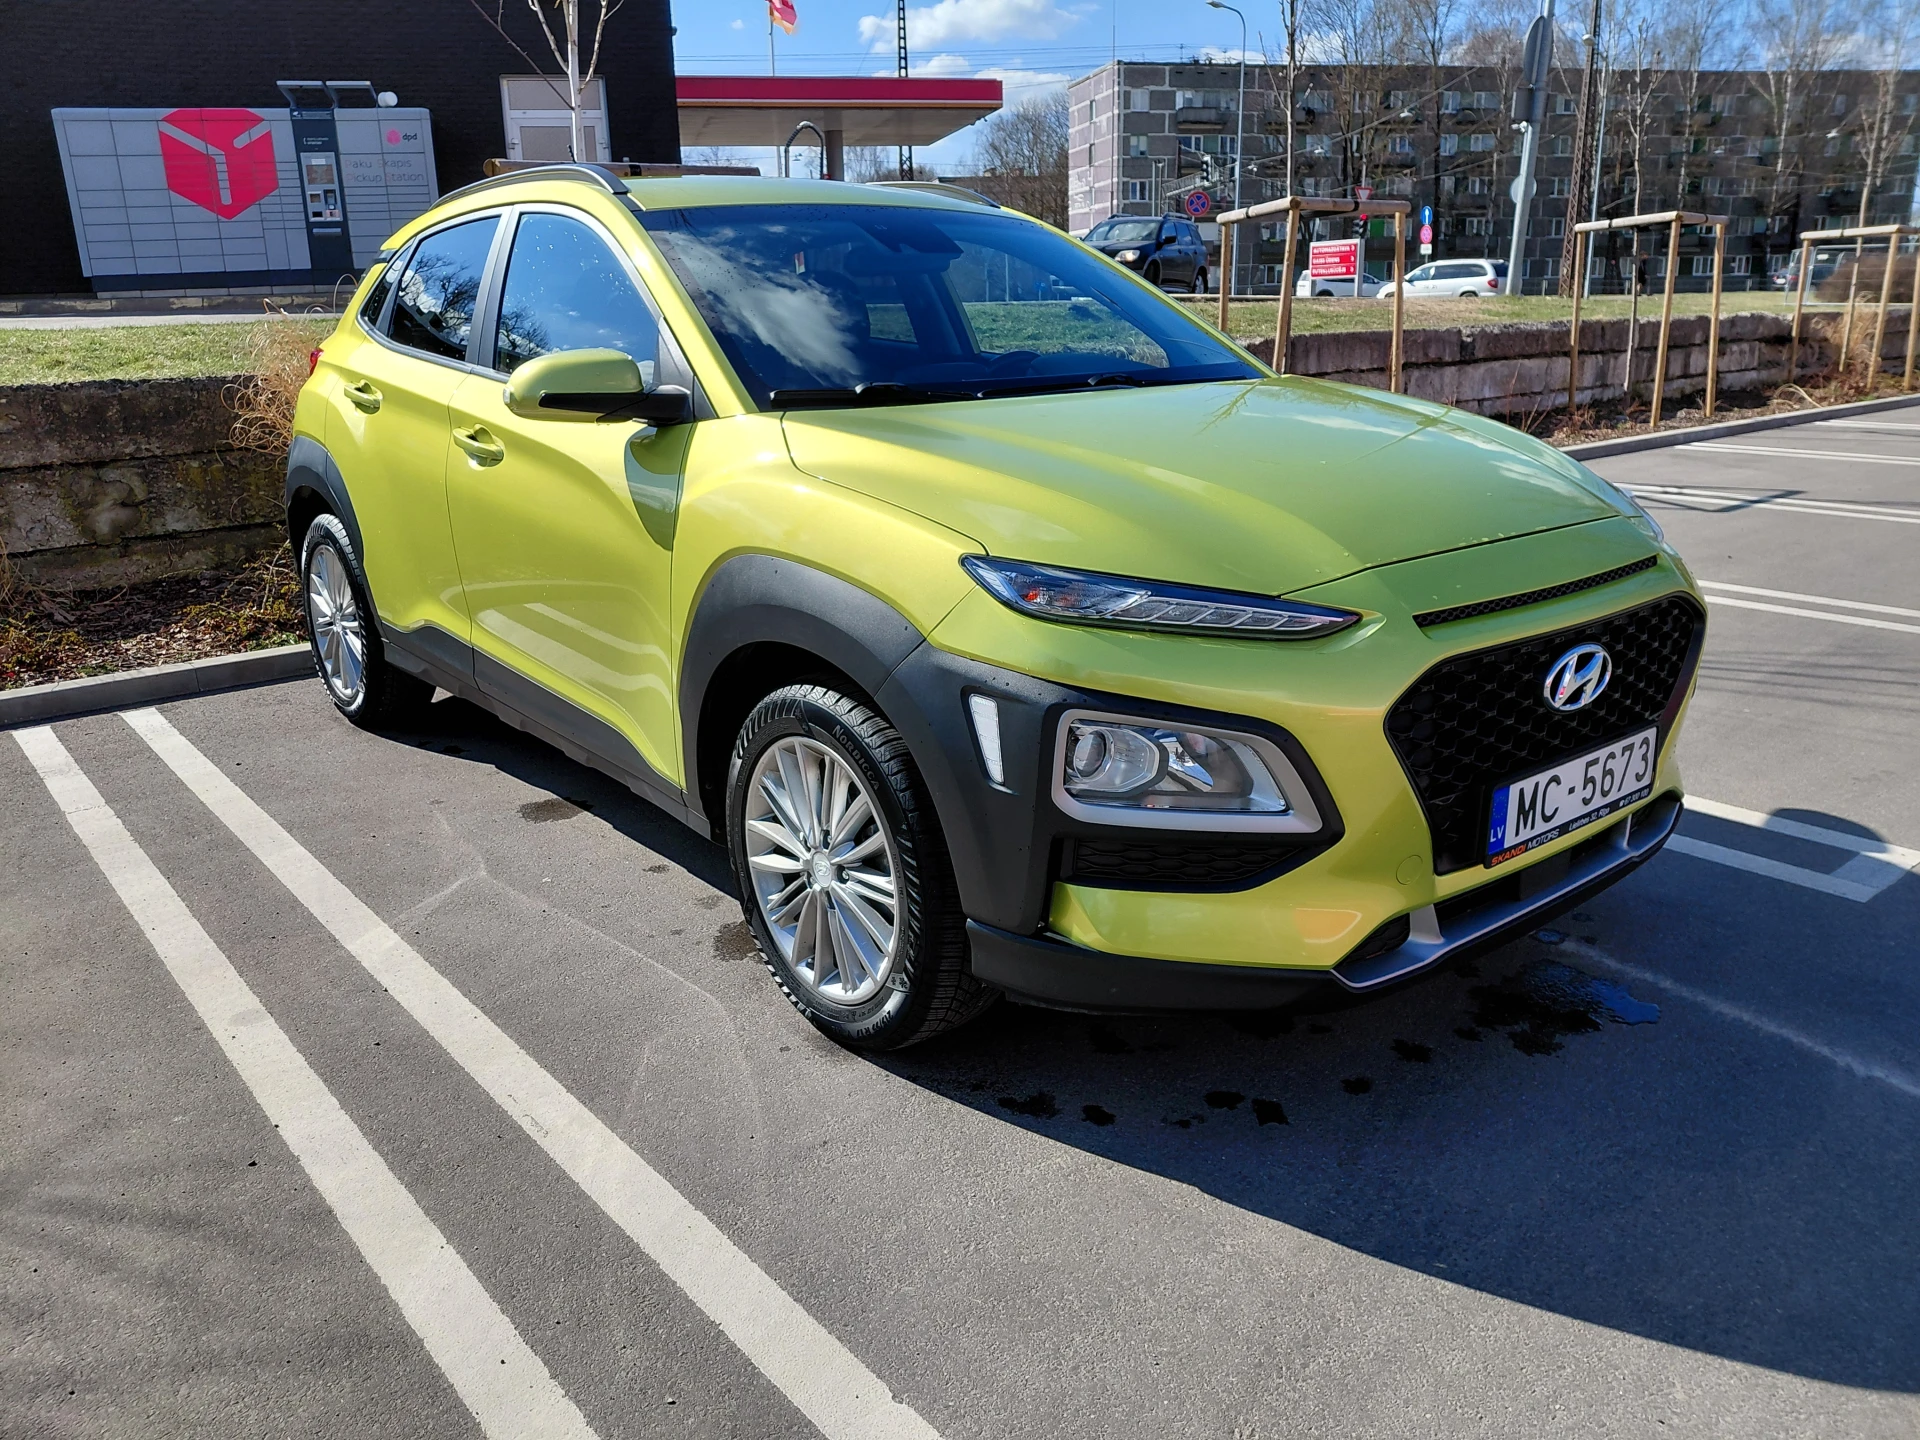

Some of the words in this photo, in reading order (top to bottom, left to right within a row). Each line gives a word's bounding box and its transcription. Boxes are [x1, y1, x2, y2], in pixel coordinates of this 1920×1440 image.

[402, 133, 418, 142] dpd
[345, 160, 373, 169] Paku
[377, 159, 412, 170] Skapis
[346, 172, 383, 184] Pickup
[385, 172, 424, 184] Station
[1514, 736, 1651, 838] MC-5673
[1489, 825, 1505, 843] LV
[1491, 844, 1527, 866] SKANDI
[1526, 829, 1560, 850] MOTORS
